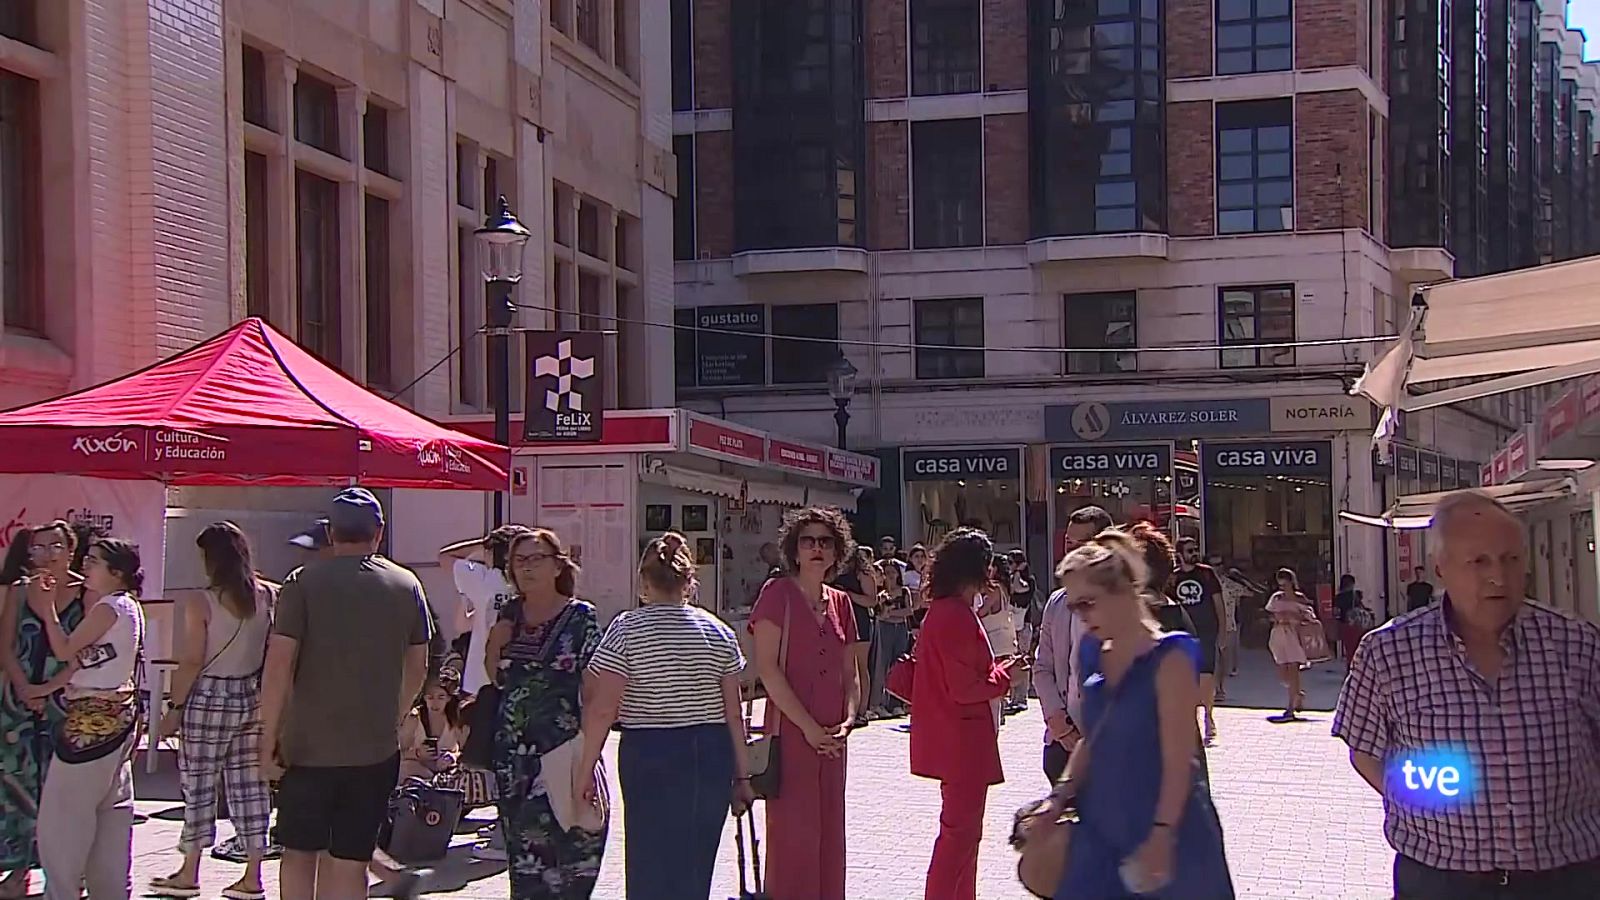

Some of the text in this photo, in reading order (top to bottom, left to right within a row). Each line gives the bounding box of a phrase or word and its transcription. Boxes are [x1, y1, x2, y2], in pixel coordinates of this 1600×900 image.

[701, 312, 759, 327] gustatio
[1121, 410, 1238, 424] ÁLVAREZ SOLER
[1286, 406, 1355, 419] NOTARÍA
[156, 431, 199, 443] Cultura
[154, 446, 225, 460] y Educación
[1217, 446, 1317, 466] casa viva
[915, 454, 1008, 473] casa viva
[1062, 451, 1159, 470] casa viva
